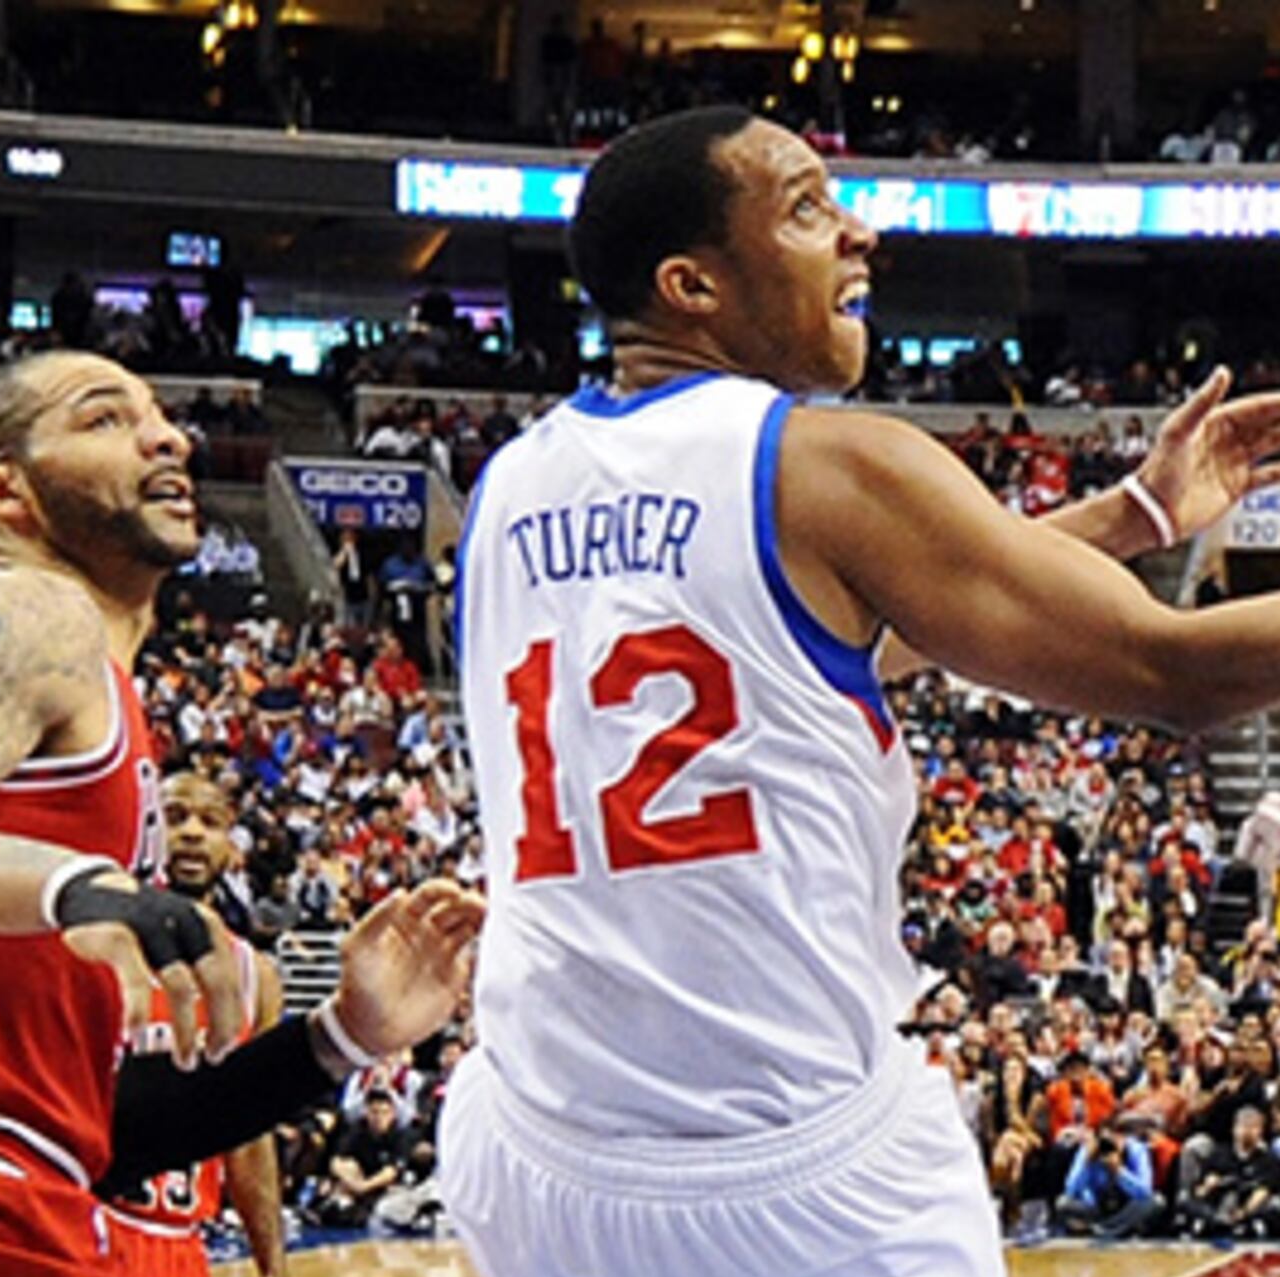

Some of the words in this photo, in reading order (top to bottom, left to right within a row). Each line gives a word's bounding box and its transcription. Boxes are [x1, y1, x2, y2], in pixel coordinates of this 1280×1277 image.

[299, 468, 409, 496] GEICO
[372, 502, 421, 529] 120
[507, 493, 701, 588] TURNER
[1232, 518, 1277, 543] 120
[504, 622, 762, 885] 12
